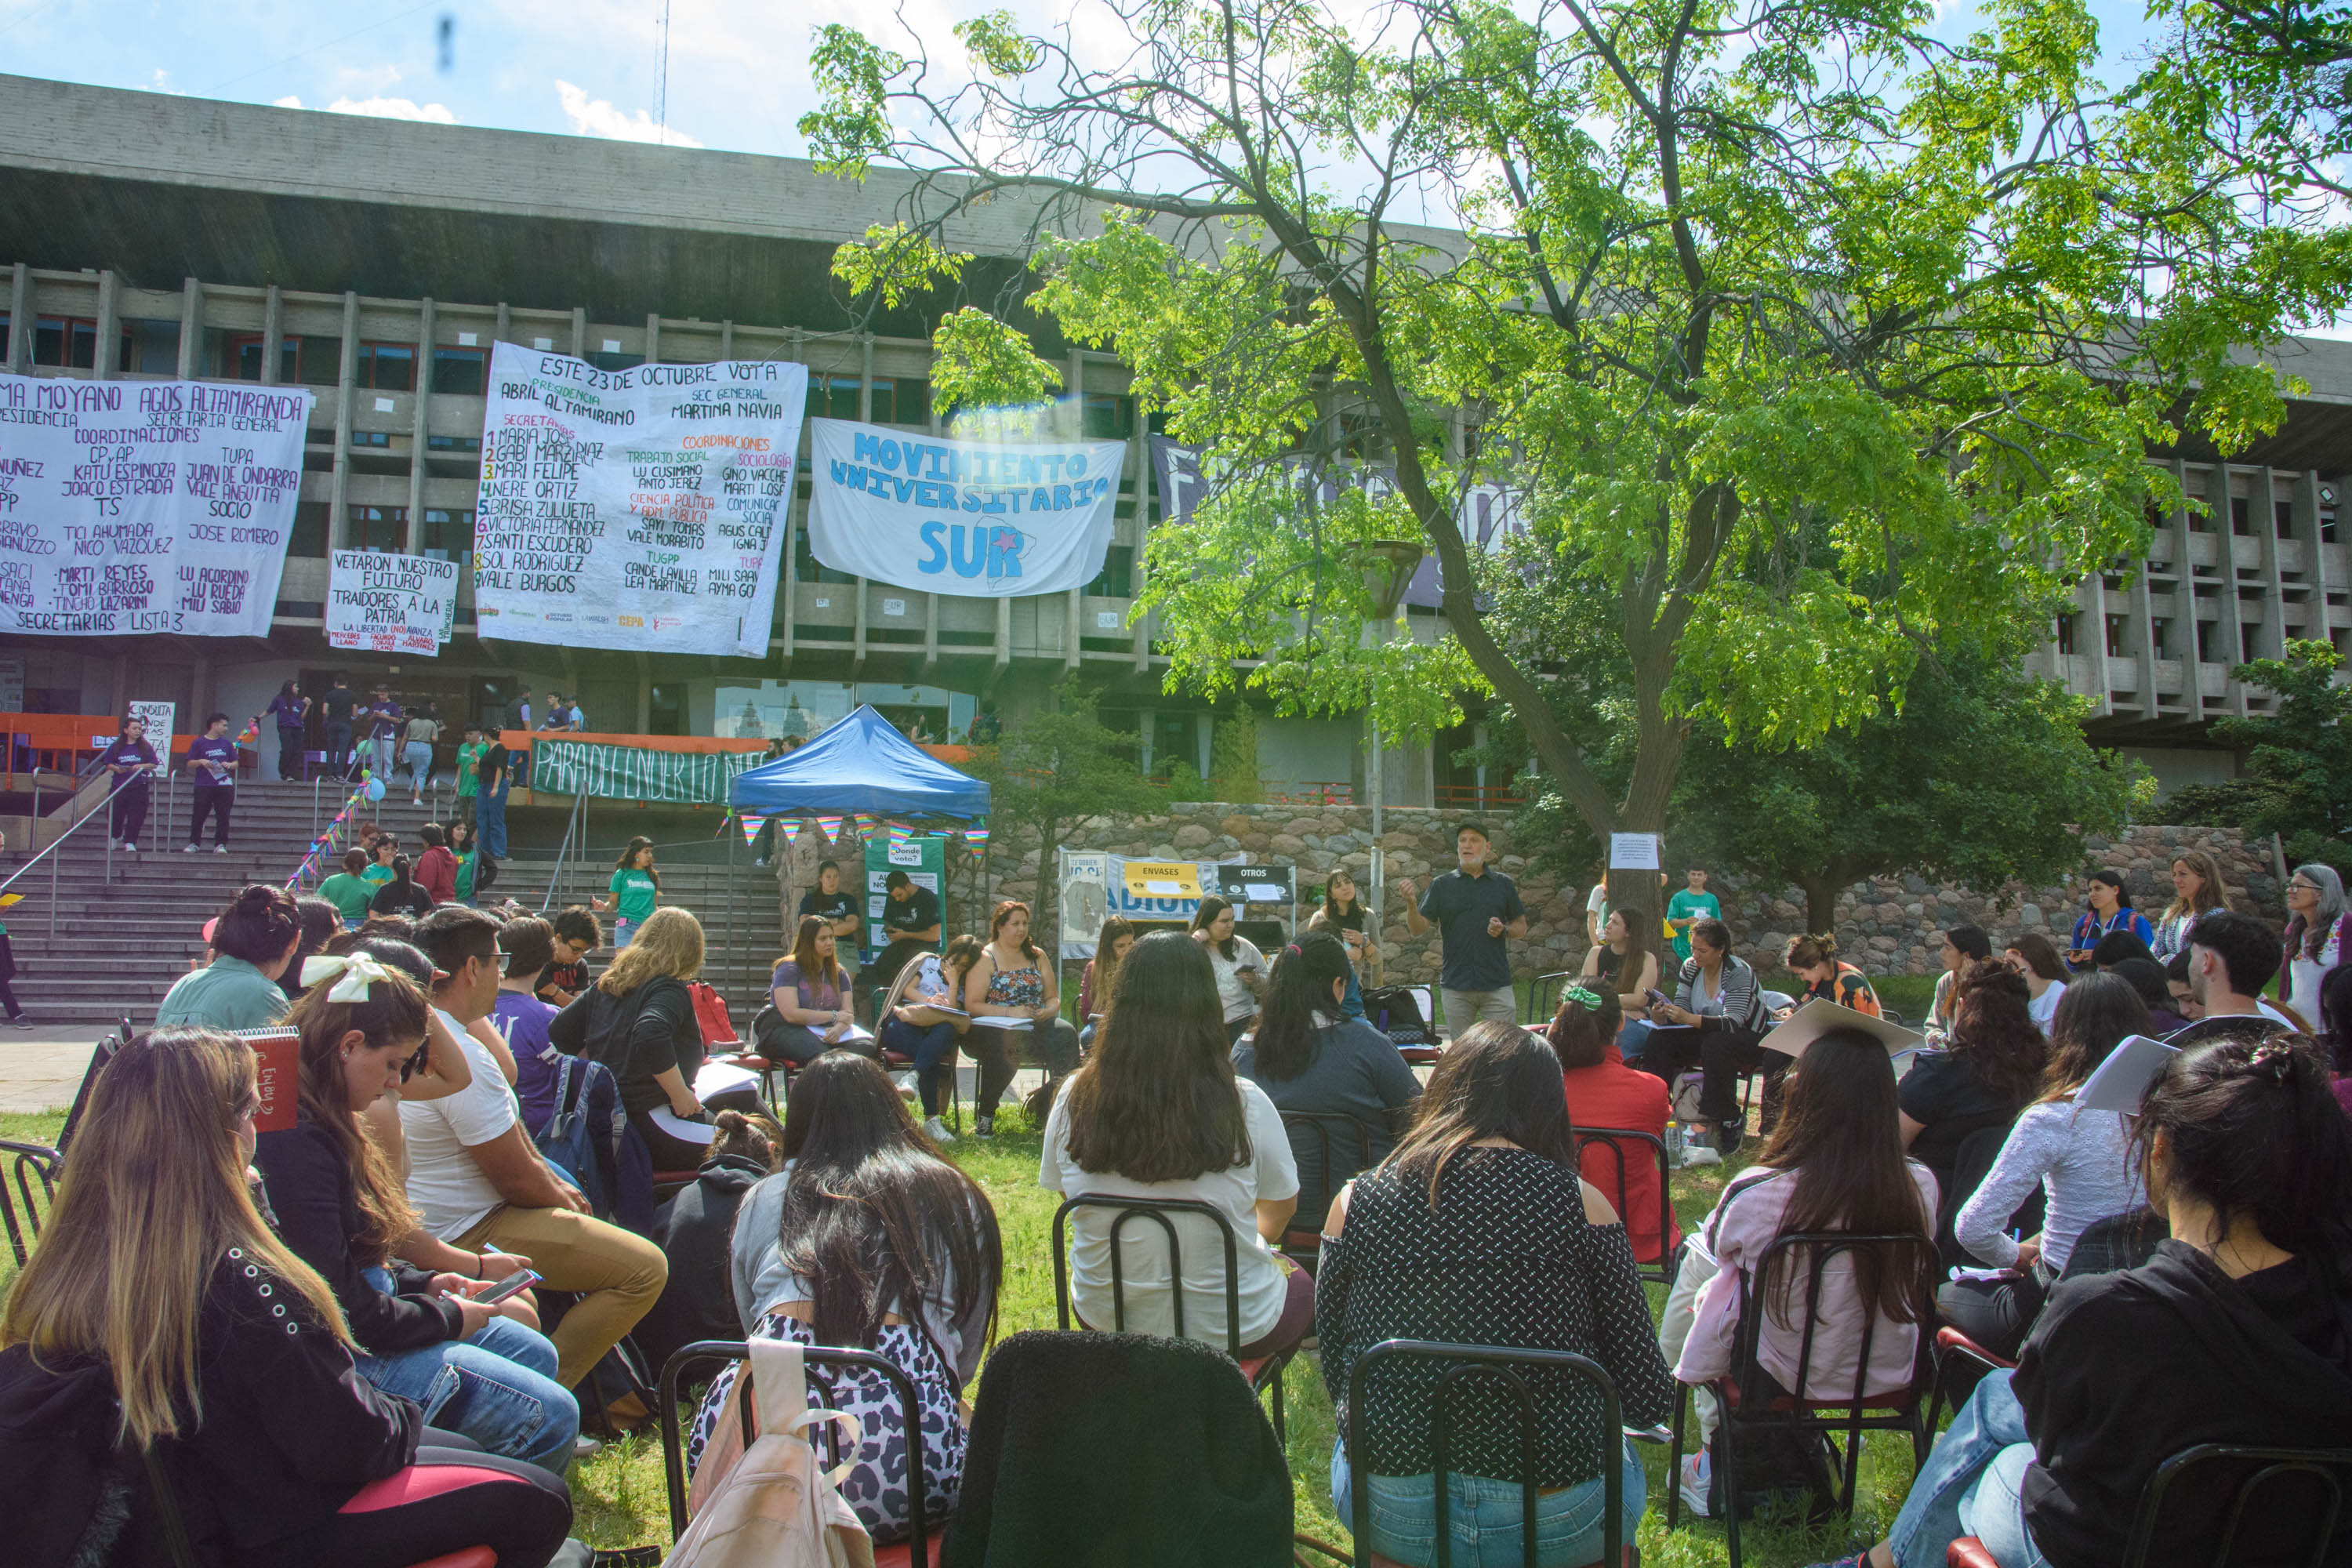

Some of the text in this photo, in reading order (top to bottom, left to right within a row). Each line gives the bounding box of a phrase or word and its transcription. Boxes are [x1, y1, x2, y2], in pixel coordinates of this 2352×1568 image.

[540, 357, 584, 381] ESTE
[588, 369, 608, 390] 23
[614, 372, 633, 391] DE
[642, 364, 717, 385] OCTUBRE
[532, 378, 601, 405] PRESIDENCIA
[691, 388, 768, 401] SEC GENERAL
[38, 385, 122, 412] MOYANO
[140, 386, 183, 413] AGOS
[191, 385, 303, 421] ALTAMIRANDA
[501, 382, 635, 426] ABRIL ALTAMIRANO
[671, 402, 782, 420] MARTINA NAVIA
[0, 408, 78, 427] ESIDENCIA
[146, 411, 282, 433] SECRETARIA GENERAL
[74, 426, 200, 445] COORDINACIONES
[499, 428, 539, 445] MARIA
[576, 441, 604, 460] DIAZ
[683, 434, 770, 452] COORDINACIONES
[90, 446, 108, 463] CP
[116, 446, 134, 463] AP
[222, 447, 254, 465] TUPA
[496, 445, 528, 462] GABI
[627, 451, 709, 464] TRABAJO SOCIAL
[738, 452, 792, 468] SOCIOLOGÍA
[854, 431, 1087, 485] MOVIMIENTO
[74, 463, 176, 481] KATU ESPINOZA
[187, 463, 299, 491] JUAN DE ONDARRA
[495, 463, 527, 480] MARI
[533, 463, 581, 481] FELIPE
[633, 464, 703, 477] LU CUSIMANO
[722, 466, 747, 481] GINO
[61, 477, 173, 496] JOACO ESTRADA
[187, 480, 281, 503] VALE ANGUITA
[492, 480, 529, 497] NERE
[535, 481, 579, 500] ORTIZ
[638, 476, 702, 490] ANTO JEREZ
[724, 482, 754, 495] MARTI
[830, 458, 1109, 514] UNIVERSITARIO
[93, 496, 122, 517] TS
[209, 500, 252, 519] SOCIO
[489, 498, 533, 517] BRISA
[536, 501, 596, 520] ZULUETA
[630, 492, 715, 510] CIENCIA POLÍTICA
[630, 503, 638, 515] Y
[669, 505, 708, 524] PÚBLICA
[93, 522, 154, 539] AHUMADA
[188, 523, 280, 546] JOSE ROMERO
[488, 516, 541, 534] VICTORIA
[543, 517, 605, 537] FERNANDEZ
[673, 521, 706, 536] TOMAS
[717, 524, 746, 538] AGUS
[74, 536, 173, 557] NICO VAZQUEZ
[484, 533, 524, 550] SANTI
[528, 534, 593, 554] ESCUDERO
[627, 529, 705, 550] VALE MORABITO
[733, 538, 757, 550] IGNA
[645, 550, 681, 564] TUGPP
[916, 520, 1024, 579] SUR
[336, 554, 452, 579] VETARON NUESTRO
[482, 550, 507, 570] SOL
[512, 551, 584, 572] RODRIGUEZ
[59, 564, 148, 583] MARTI REYES
[180, 565, 249, 585] LU ACORDINO
[363, 571, 423, 590] FUTURO
[481, 570, 576, 593] VALE BURGOS
[625, 562, 698, 583] CANDE LAVILLA
[709, 569, 730, 581] MILI
[57, 579, 154, 597] TOMI BARROSO
[191, 582, 245, 601] LU RUEDA
[625, 575, 698, 595] LEA MARTINEZ
[709, 582, 735, 597] AYMA
[53, 595, 148, 612] TINCHO LAZARINI
[212, 600, 241, 615] SABIO
[333, 590, 439, 615] TRAIDORES A LA
[16, 610, 185, 631] SECRETARIAS LISTA 3
[365, 608, 406, 625] PATRIA
[343, 623, 354, 632] LA
[357, 624, 388, 634] LIBERTAD
[406, 626, 433, 637] AVANZA
[535, 741, 586, 791] PARA
[588, 744, 685, 801] DEFENDER
[691, 753, 717, 804] LO
[1142, 866, 1267, 877] ENVASES OTROS
